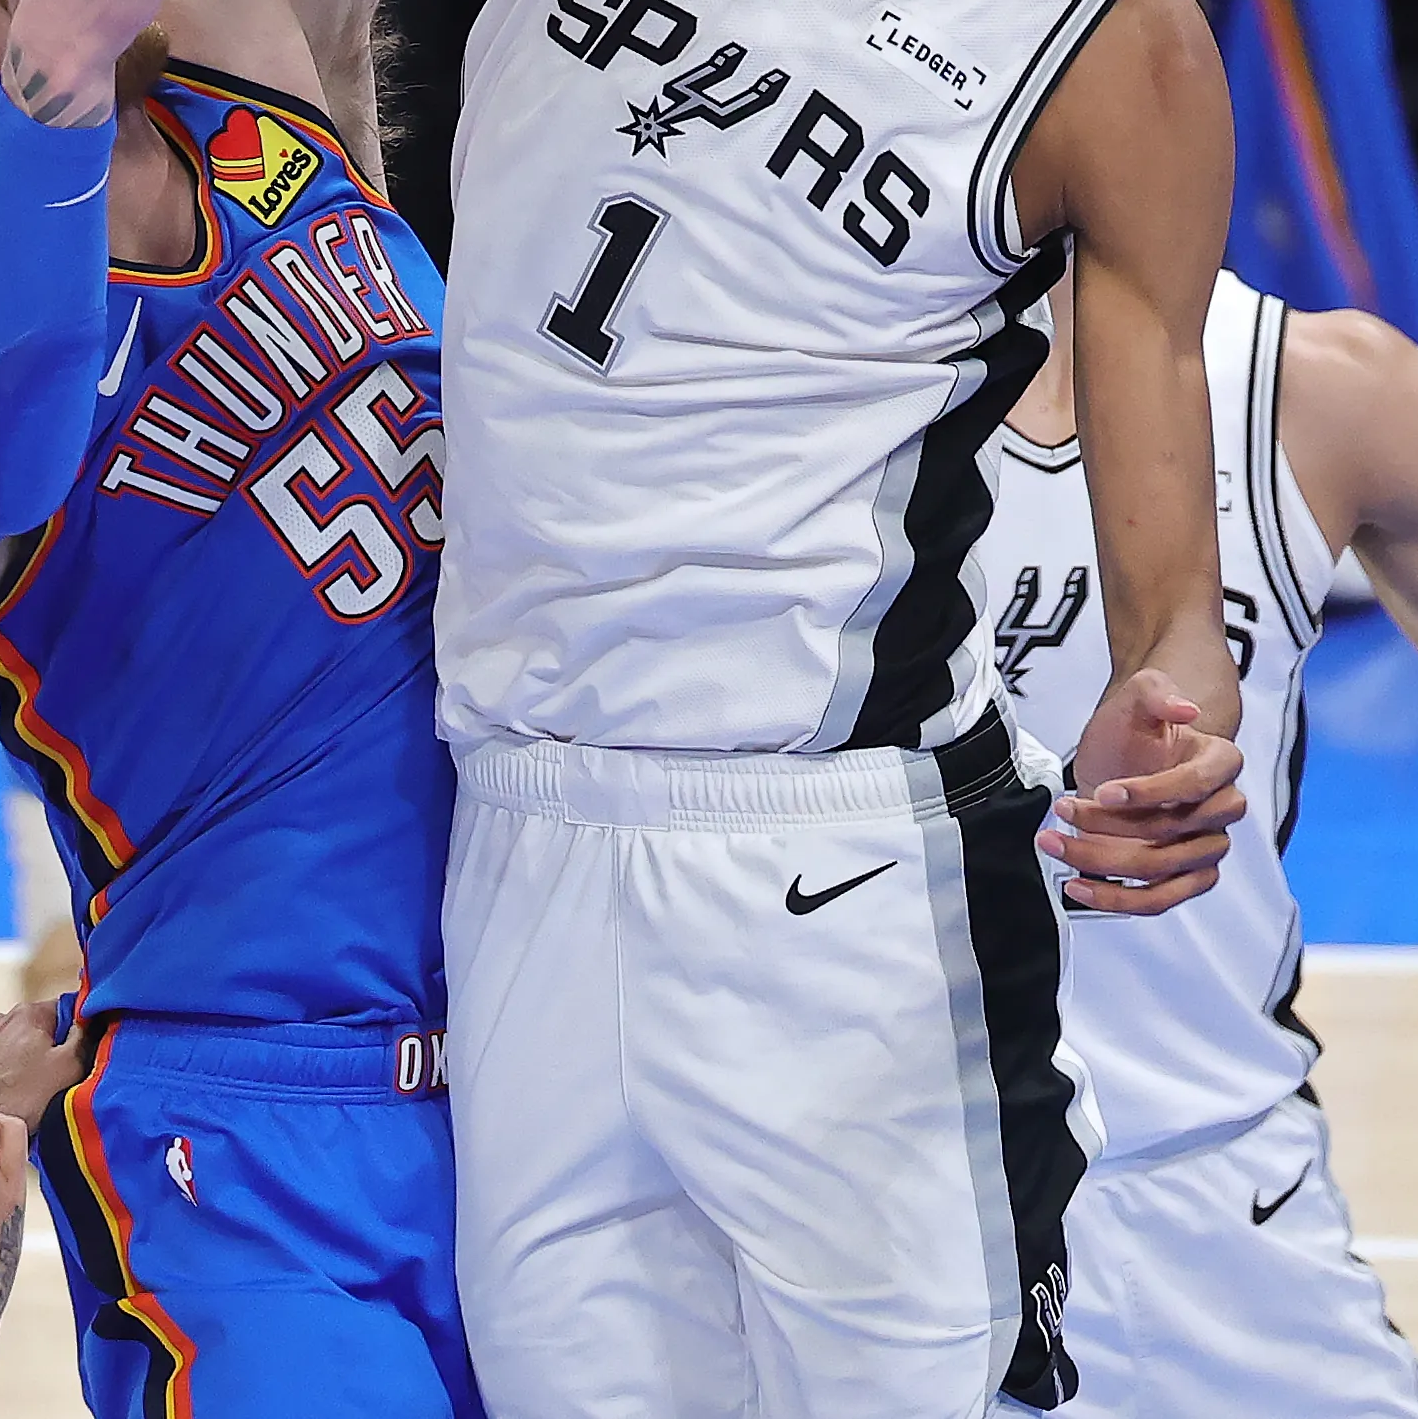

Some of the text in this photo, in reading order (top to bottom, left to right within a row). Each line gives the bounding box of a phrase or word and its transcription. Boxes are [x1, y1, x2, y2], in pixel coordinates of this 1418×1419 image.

[886, 28, 968, 91] LEDGER
[98, 210, 433, 517] THUNDER
[537, 192, 670, 376] 1
[239, 360, 446, 625] 55
